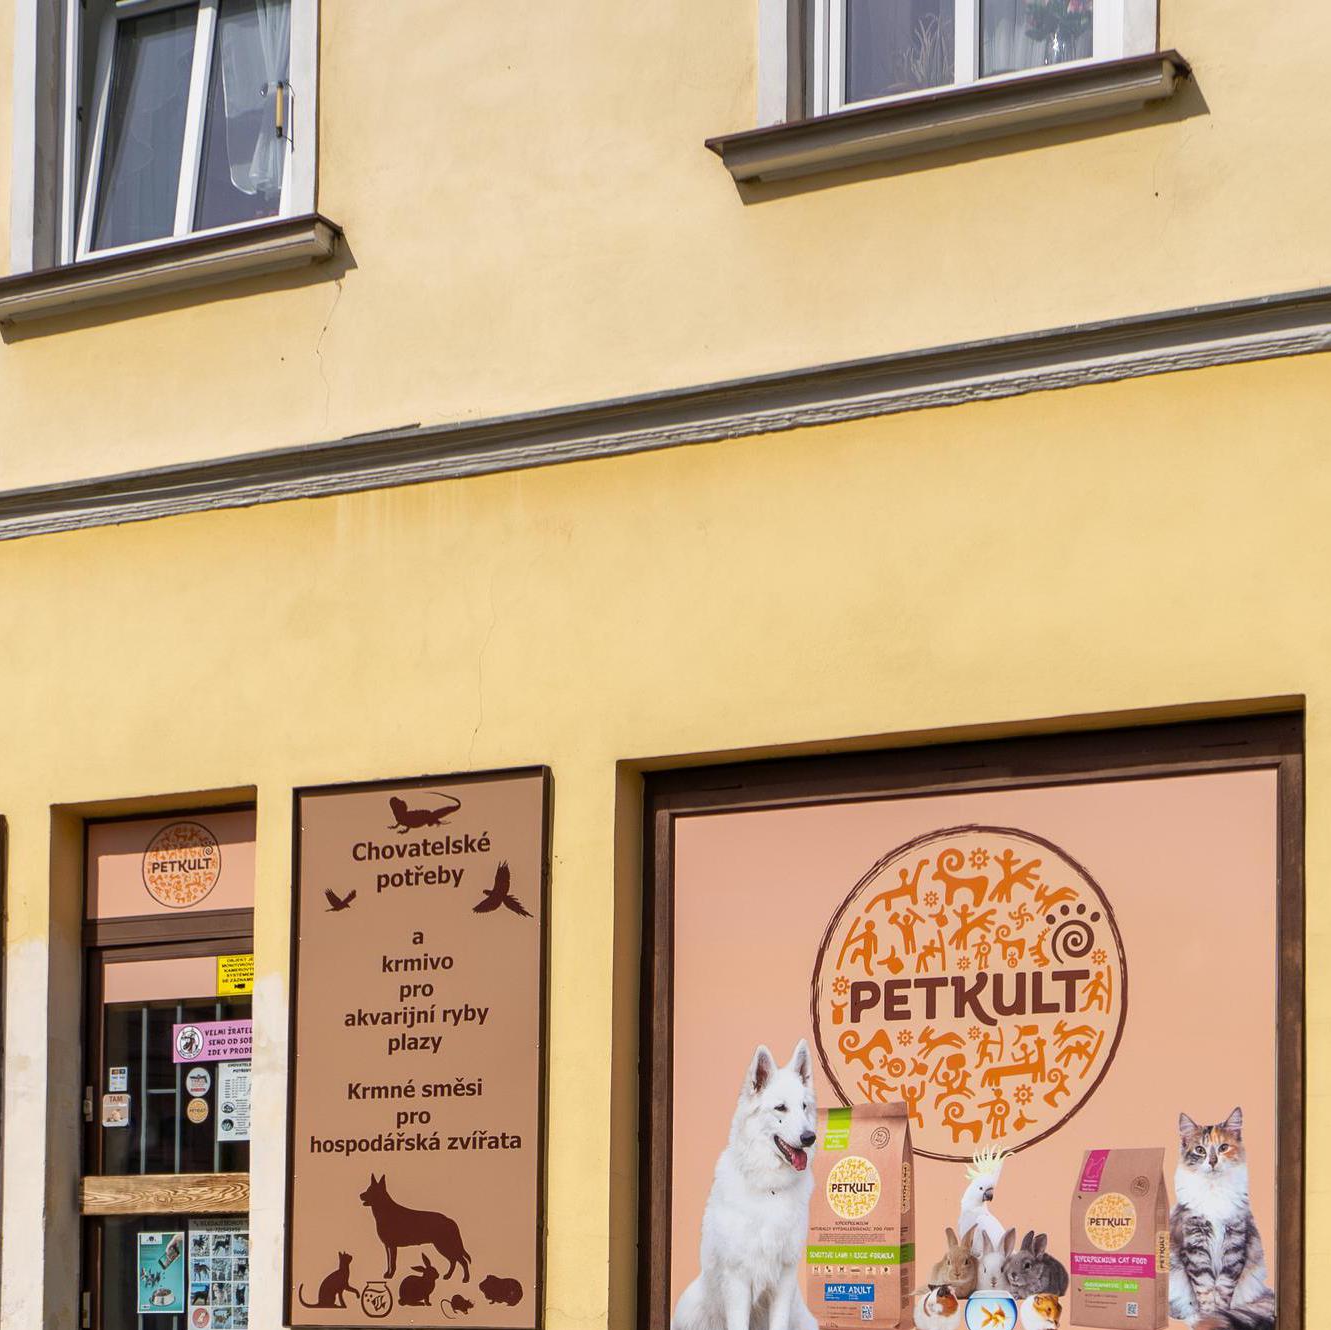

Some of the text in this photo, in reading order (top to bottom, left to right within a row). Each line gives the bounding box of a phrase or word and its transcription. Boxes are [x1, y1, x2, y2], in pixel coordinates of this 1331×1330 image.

[351, 832, 490, 862] Chovatelské
[151, 857, 212, 873] PETKULT
[376, 865, 464, 893] potřeby
[412, 931, 424, 945] a
[382, 952, 453, 973] krmivo
[399, 982, 434, 1002] pro
[850, 969, 1090, 1027] PETKULT
[344, 1004, 489, 1028] akvarijní ryby
[387, 1034, 442, 1055] plazy
[347, 1077, 482, 1100] Krmné směsi
[396, 1108, 431, 1128] pro
[310, 1130, 522, 1156] hospodářská zvířata
[831, 1183, 875, 1194] PETKULT
[1090, 1217, 1131, 1228] PETKULT
[849, 1286, 871, 1294] ADULT
